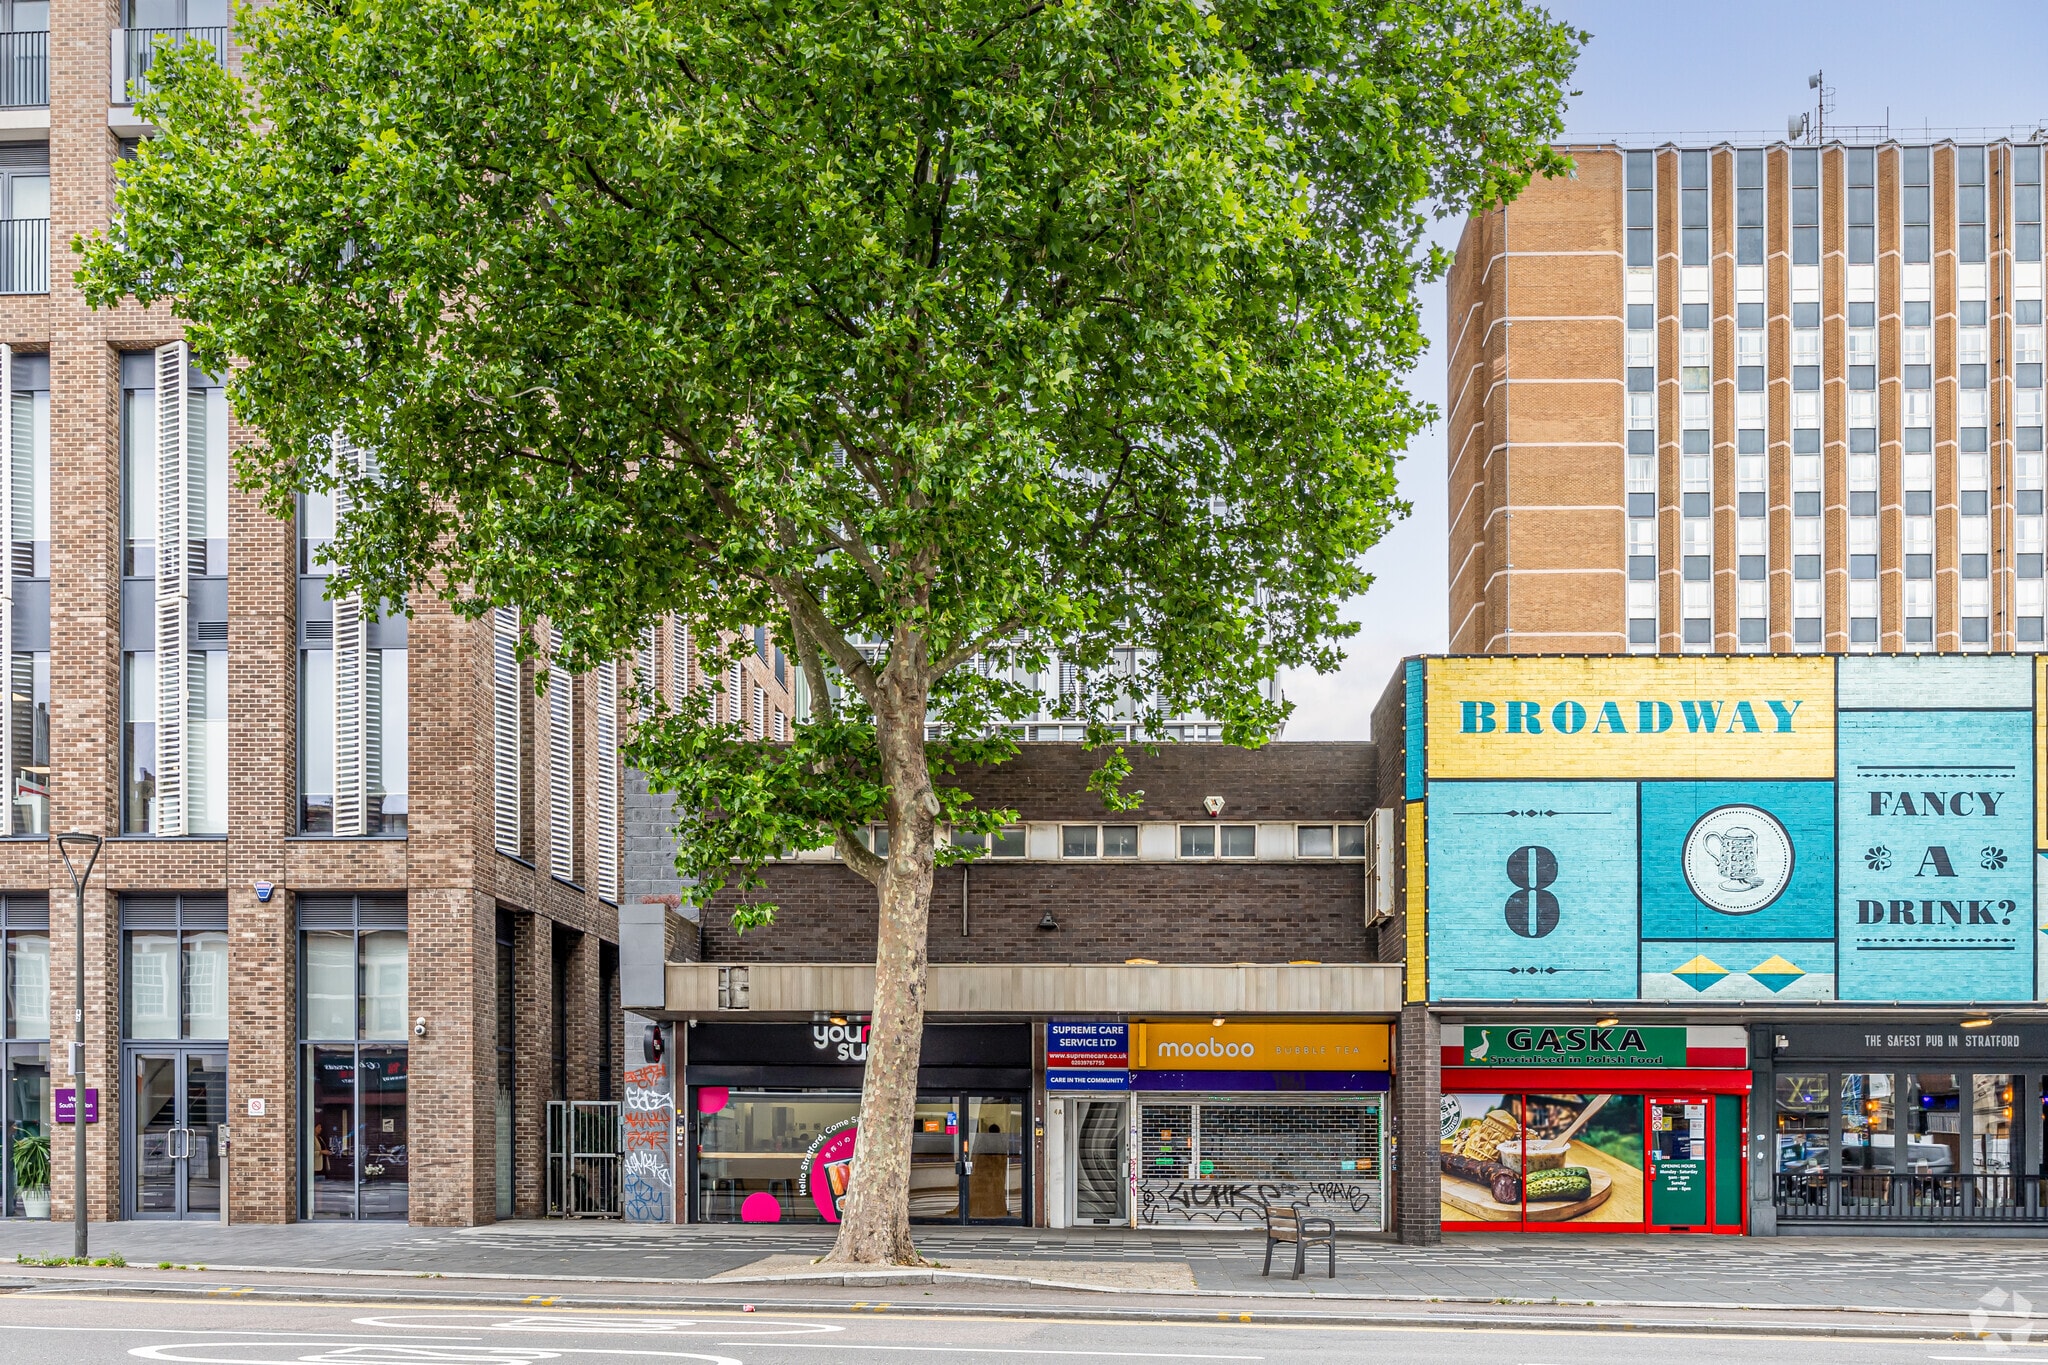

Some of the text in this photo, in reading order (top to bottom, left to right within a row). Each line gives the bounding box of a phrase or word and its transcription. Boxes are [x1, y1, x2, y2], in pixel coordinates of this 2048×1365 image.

[1459, 700, 1803, 735] BROADWAY
[1867, 791, 2005, 816] FANCY
[1914, 846, 1959, 877] A
[1504, 845, 1560, 939] 8
[1856, 899, 2017, 925] DRINK?
[1052, 1026, 1124, 1034] SUPREME CARE
[1059, 1038, 1117, 1047] SERVICE LTD
[1158, 1037, 1255, 1058] mooboo
[1276, 1046, 1359, 1055] BUBBLE TEA
[1506, 1028, 1648, 1054] GĄSKA
[1865, 1035, 2020, 1047] THE SAFEST PUB IN STRATFORD
[837, 1043, 870, 1061] su
[1049, 1052, 1127, 1060] www.supremecare.co.uk
[1490, 1055, 1663, 1064] Specialised in Polish Food
[825, 1119, 849, 1134] Come
[801, 1133, 827, 1171] Stratford,
[799, 1172, 807, 1196] Hello
